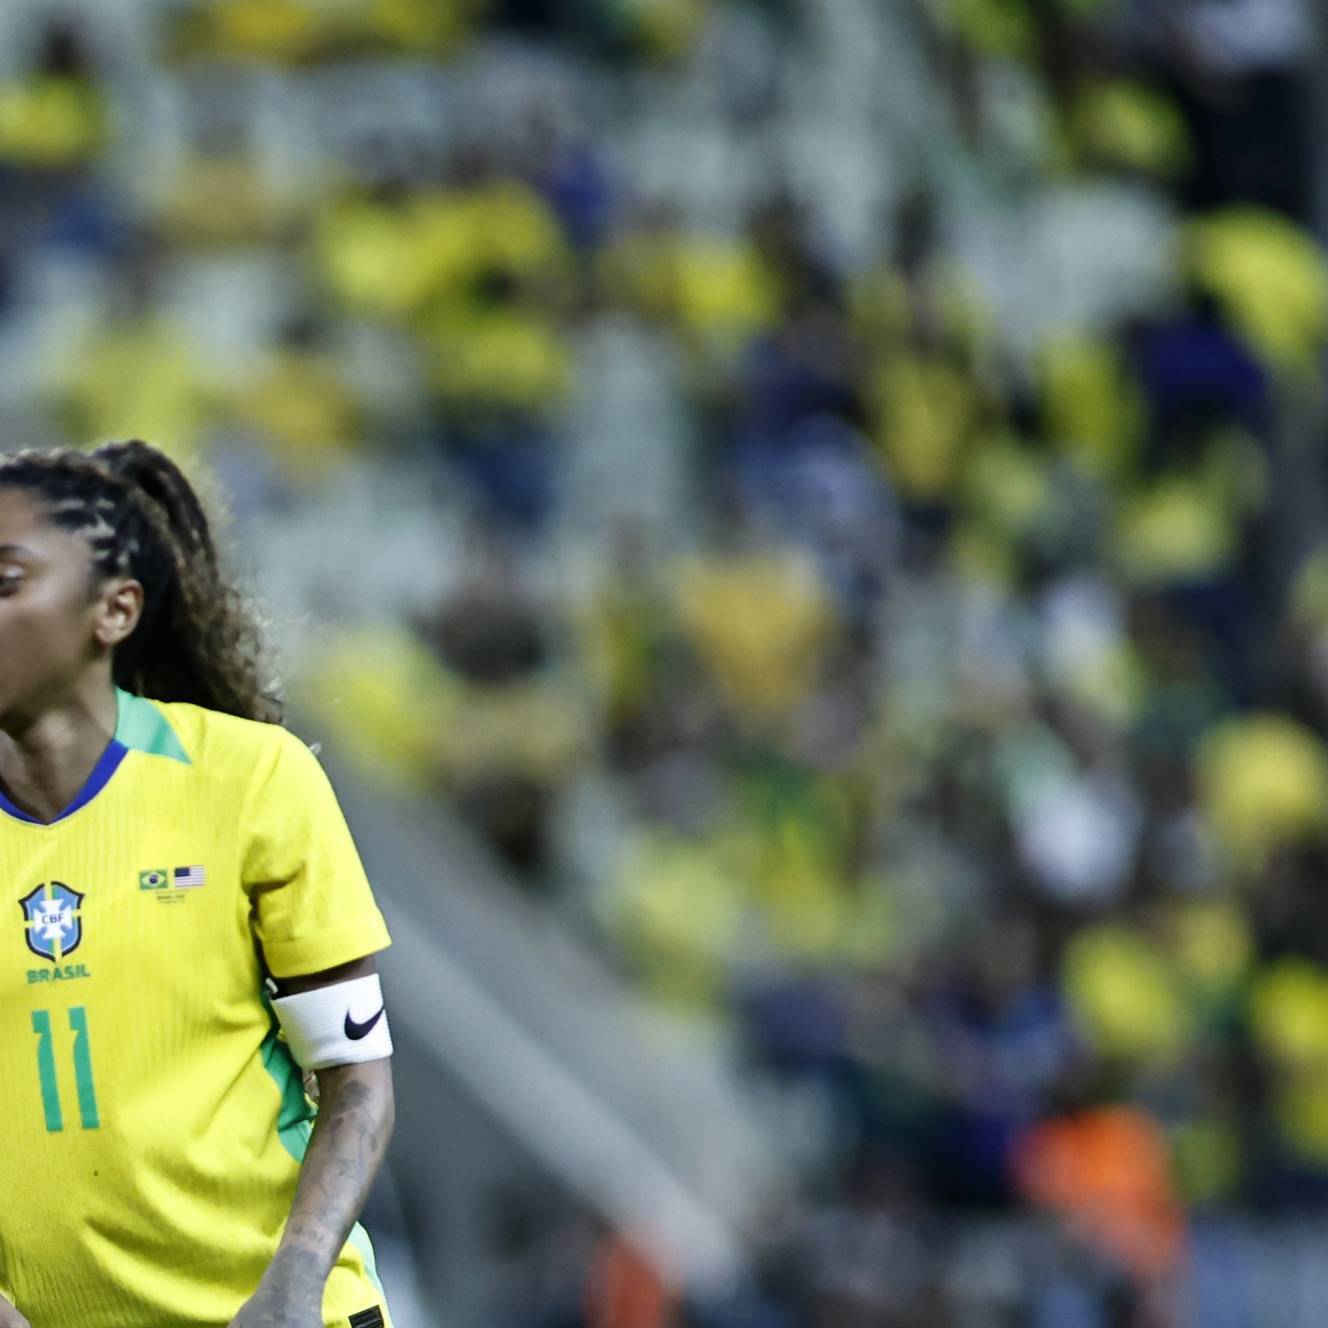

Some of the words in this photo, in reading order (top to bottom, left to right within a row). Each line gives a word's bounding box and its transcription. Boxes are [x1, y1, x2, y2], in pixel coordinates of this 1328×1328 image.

[41, 913, 64, 924] CBF
[26, 964, 91, 984] BRASIL
[31, 1006, 100, 1132] 11
